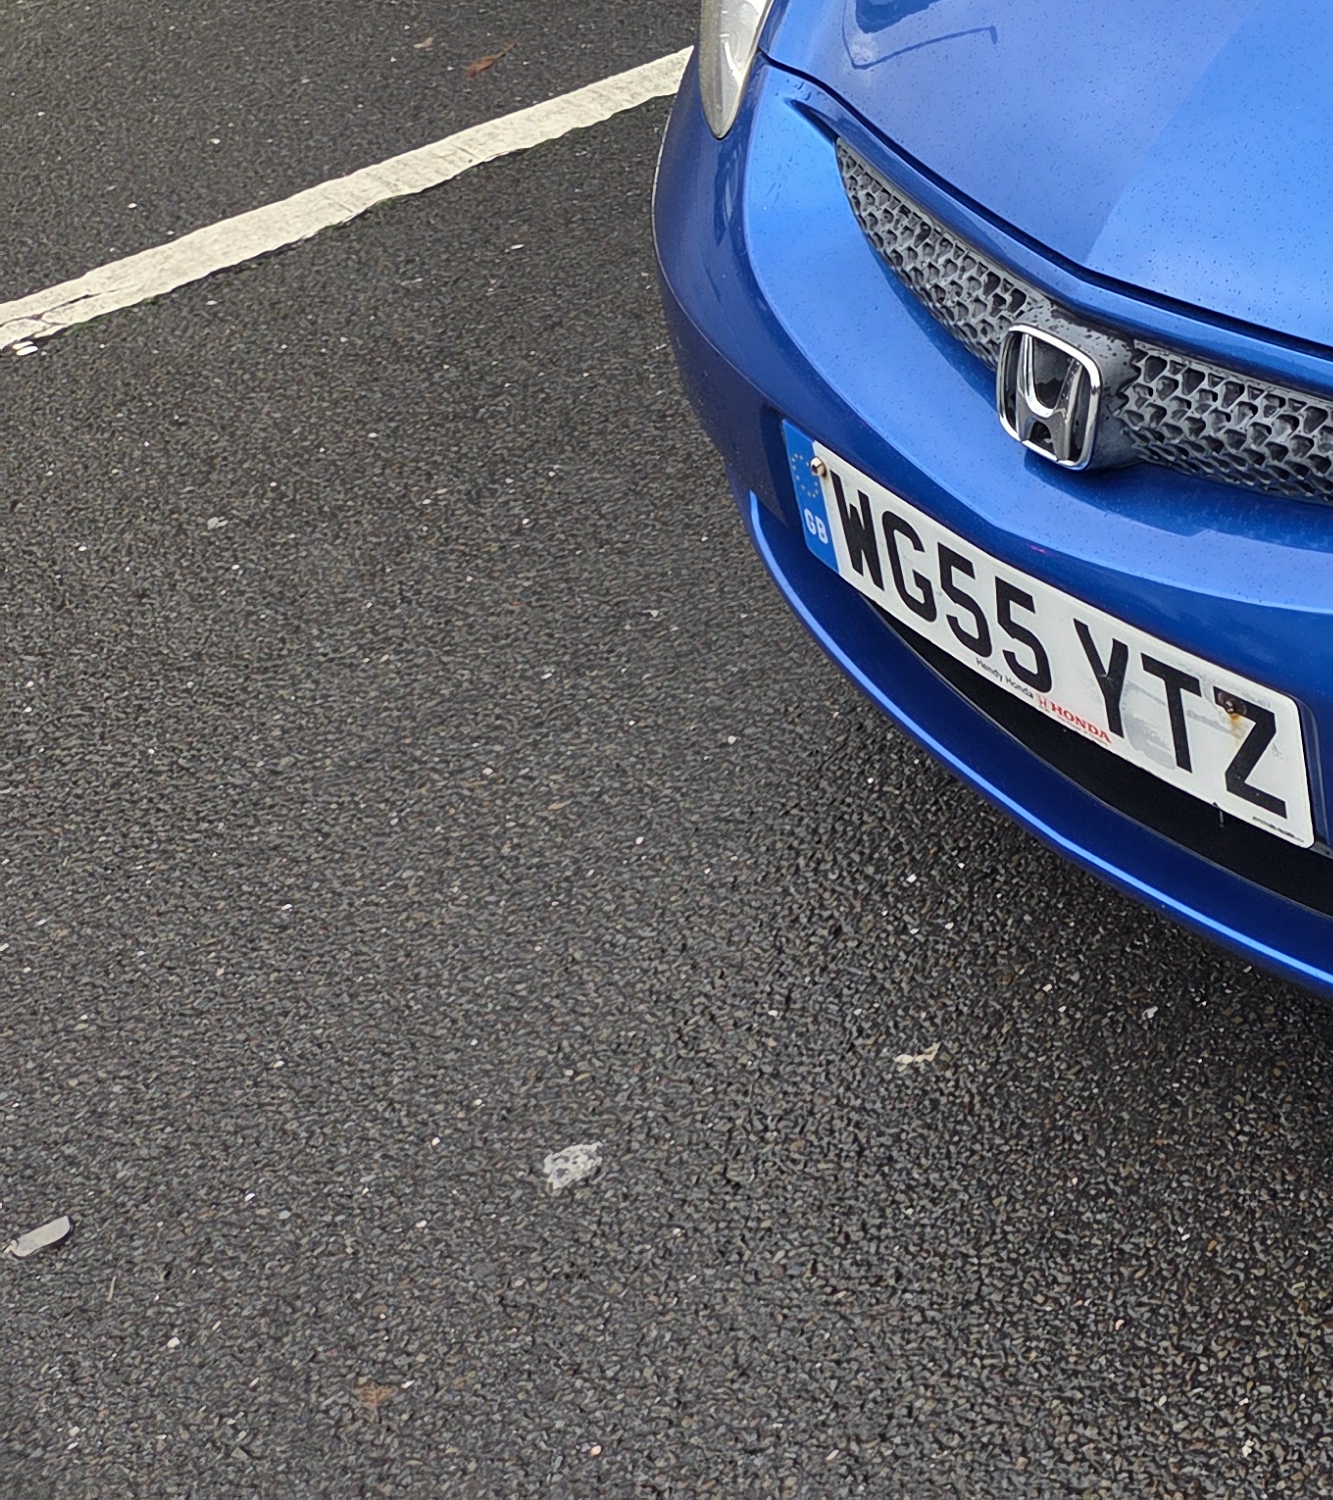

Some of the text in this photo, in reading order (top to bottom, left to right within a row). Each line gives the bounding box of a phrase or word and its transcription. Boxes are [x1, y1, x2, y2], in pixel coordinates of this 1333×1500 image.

[803, 507, 829, 545] GB
[830, 469, 1288, 820] WG55 YTZ
[1050, 701, 1113, 745] HONDA
